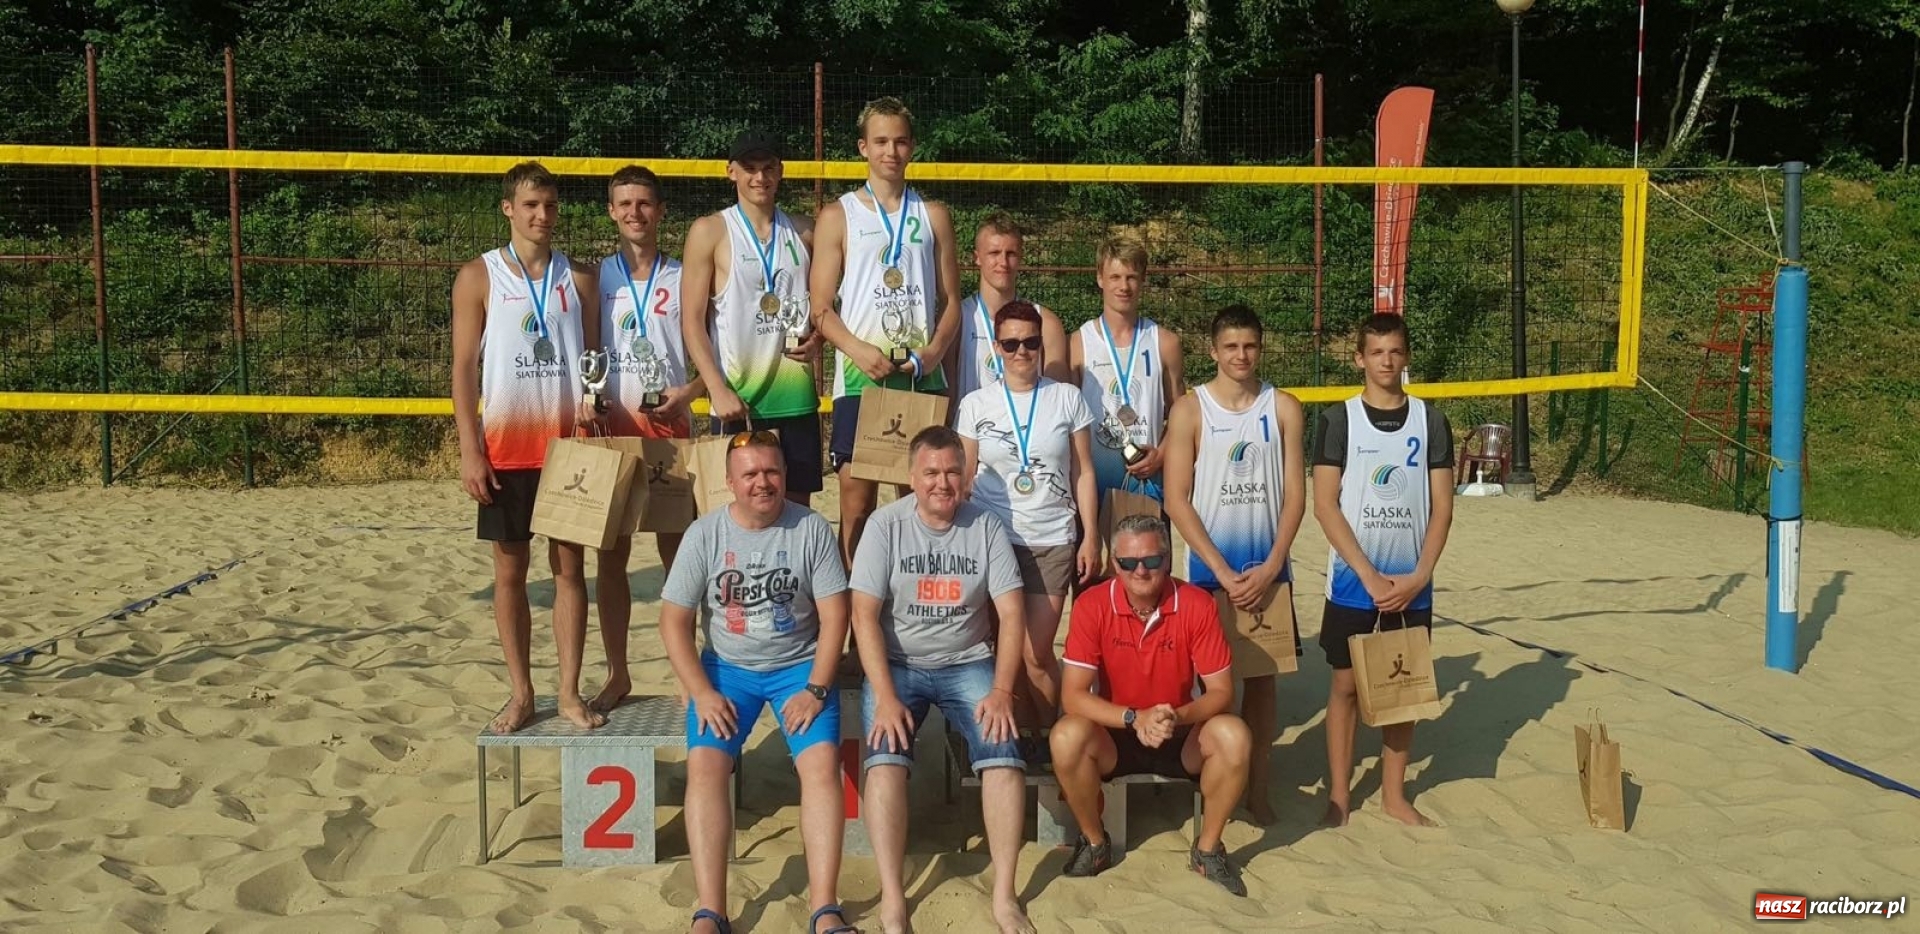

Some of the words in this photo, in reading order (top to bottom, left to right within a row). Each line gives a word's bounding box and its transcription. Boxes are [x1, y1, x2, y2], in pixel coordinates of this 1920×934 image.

[907, 216, 922, 244] 2
[785, 239, 799, 266] 1
[555, 283, 568, 313] 1
[653, 288, 670, 316] 2
[1141, 349, 1150, 377] 1
[1259, 414, 1270, 442] 1
[1406, 436, 1421, 467] 2
[1221, 481, 1267, 496] ŚLĄSKA
[1221, 495, 1267, 507] SIATKÓWKA
[1363, 506, 1412, 522] ŚLĄSKA
[1363, 518, 1412, 530] SIATKÓWKA
[900, 553, 926, 575] NEW
[928, 552, 979, 576] BALANCE
[917, 578, 961, 601] 1906
[906, 604, 968, 618] ATHLETICS
[583, 765, 637, 849] 2
